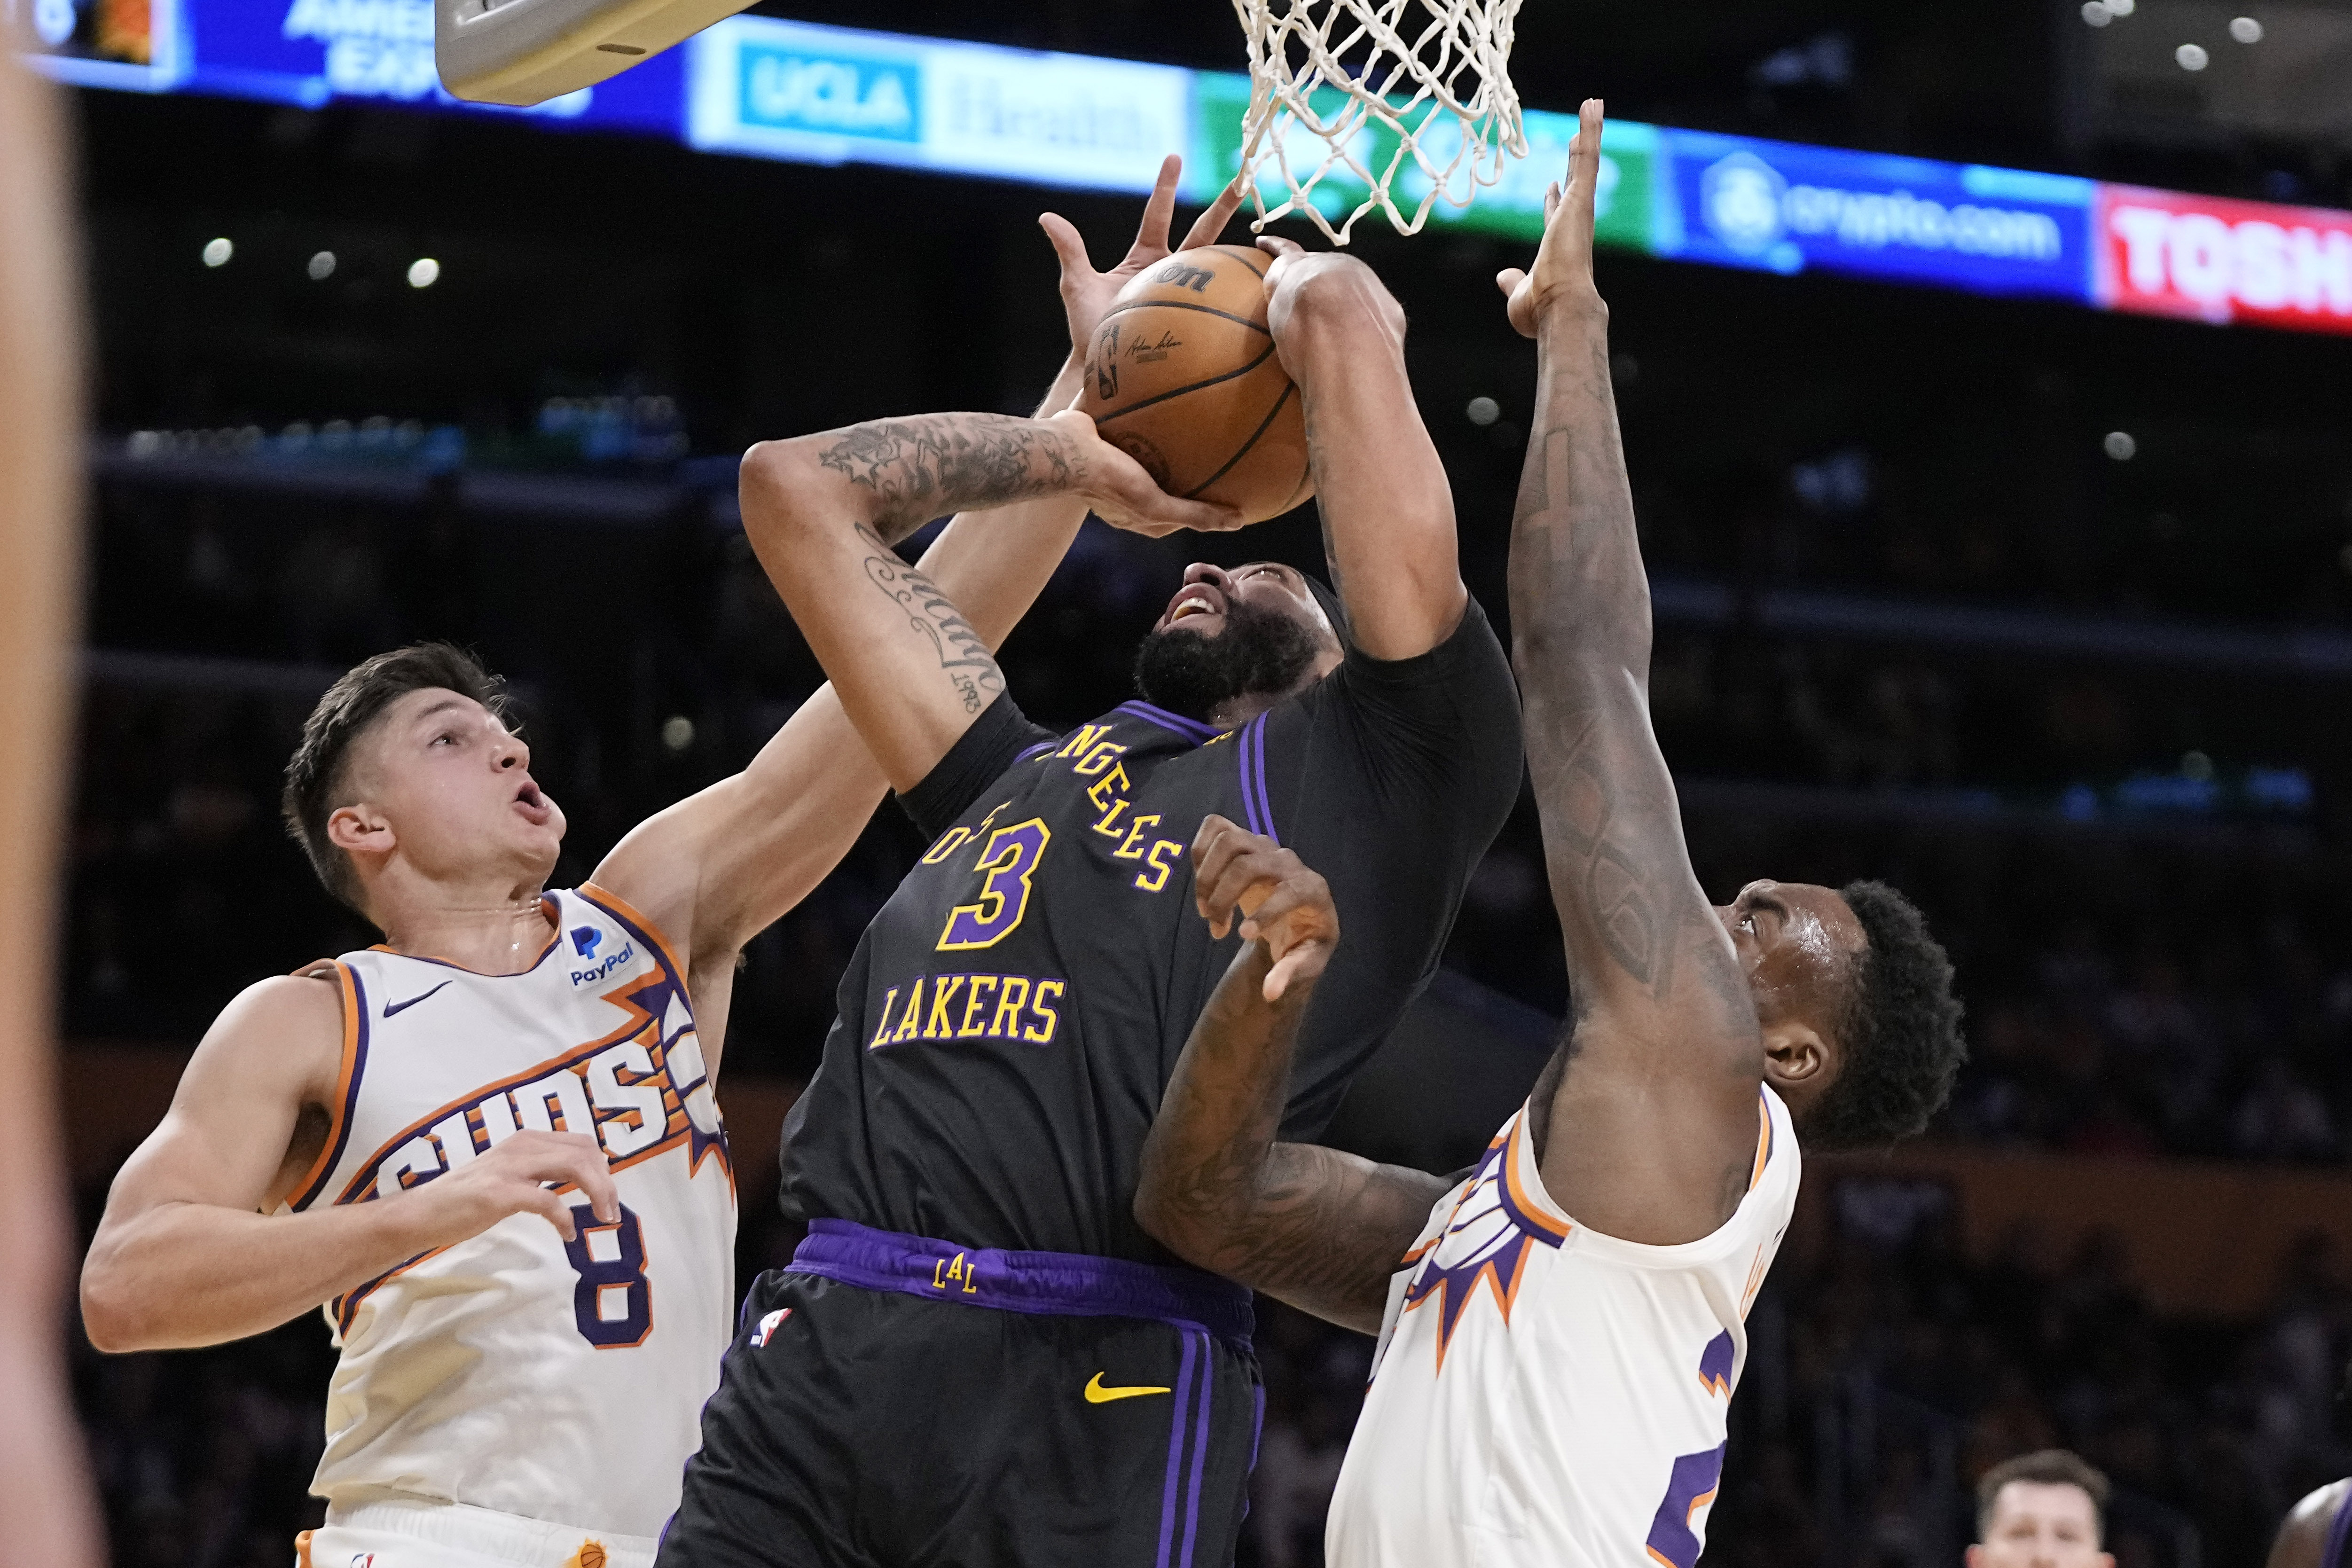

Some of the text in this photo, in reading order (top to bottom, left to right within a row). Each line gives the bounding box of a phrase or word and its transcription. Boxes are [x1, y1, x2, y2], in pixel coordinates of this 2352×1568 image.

[752, 52, 911, 128] UCLA
[1056, 724, 1184, 892] NGELES
[936, 816, 1051, 951] 3
[571, 941, 634, 986] PayPal
[870, 975, 1065, 1049] LAKERS
[564, 1201, 653, 1350] 8
[933, 1252, 977, 1294] LAL
